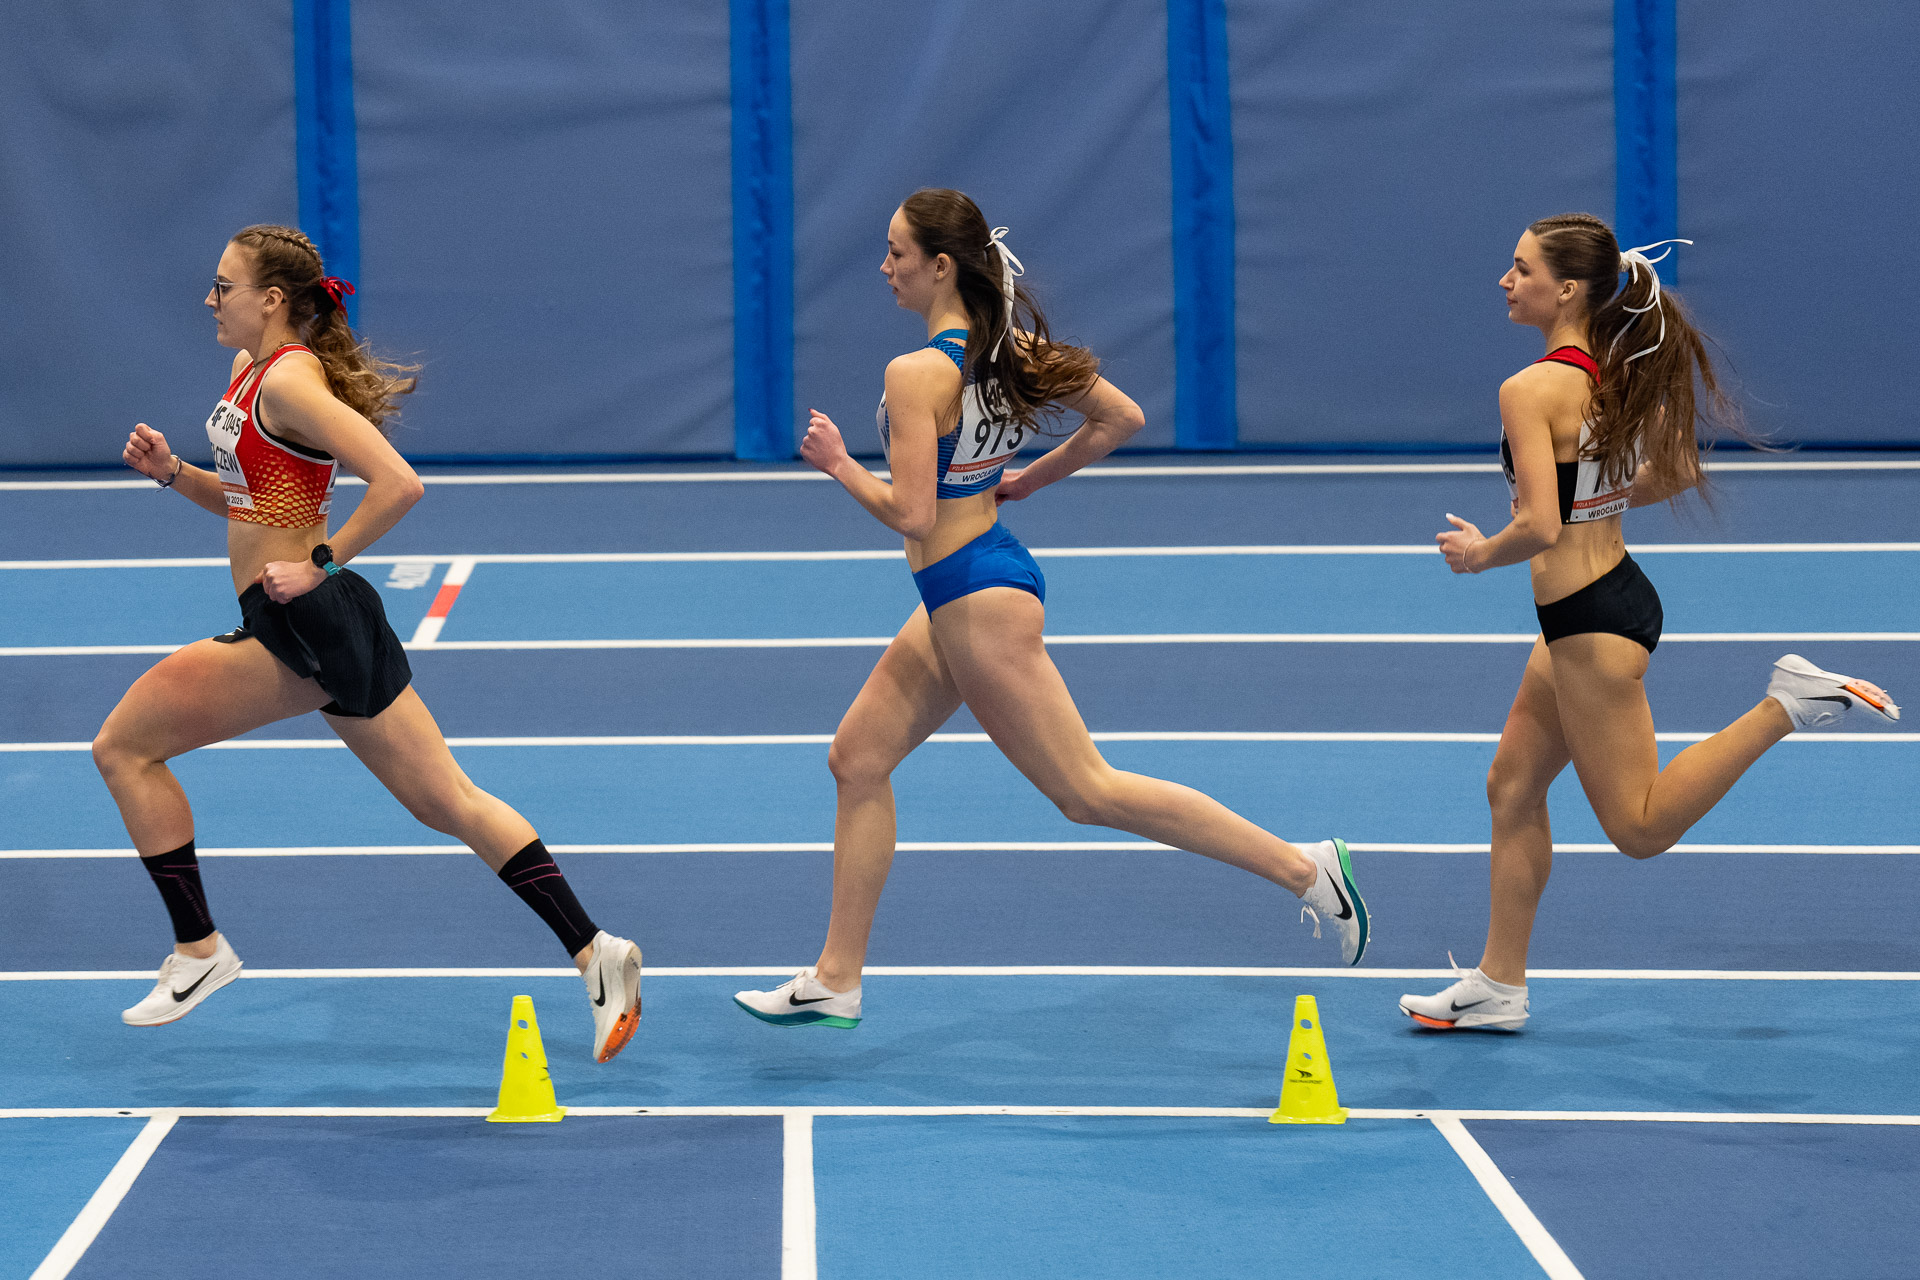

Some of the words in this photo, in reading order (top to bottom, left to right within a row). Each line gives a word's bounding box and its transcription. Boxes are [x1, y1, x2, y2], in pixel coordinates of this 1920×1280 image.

[222, 412, 242, 436] 1045
[971, 415, 1024, 459] 973
[231, 496, 243, 505] 2025
[1588, 501, 1625, 518] WROCŁAW
